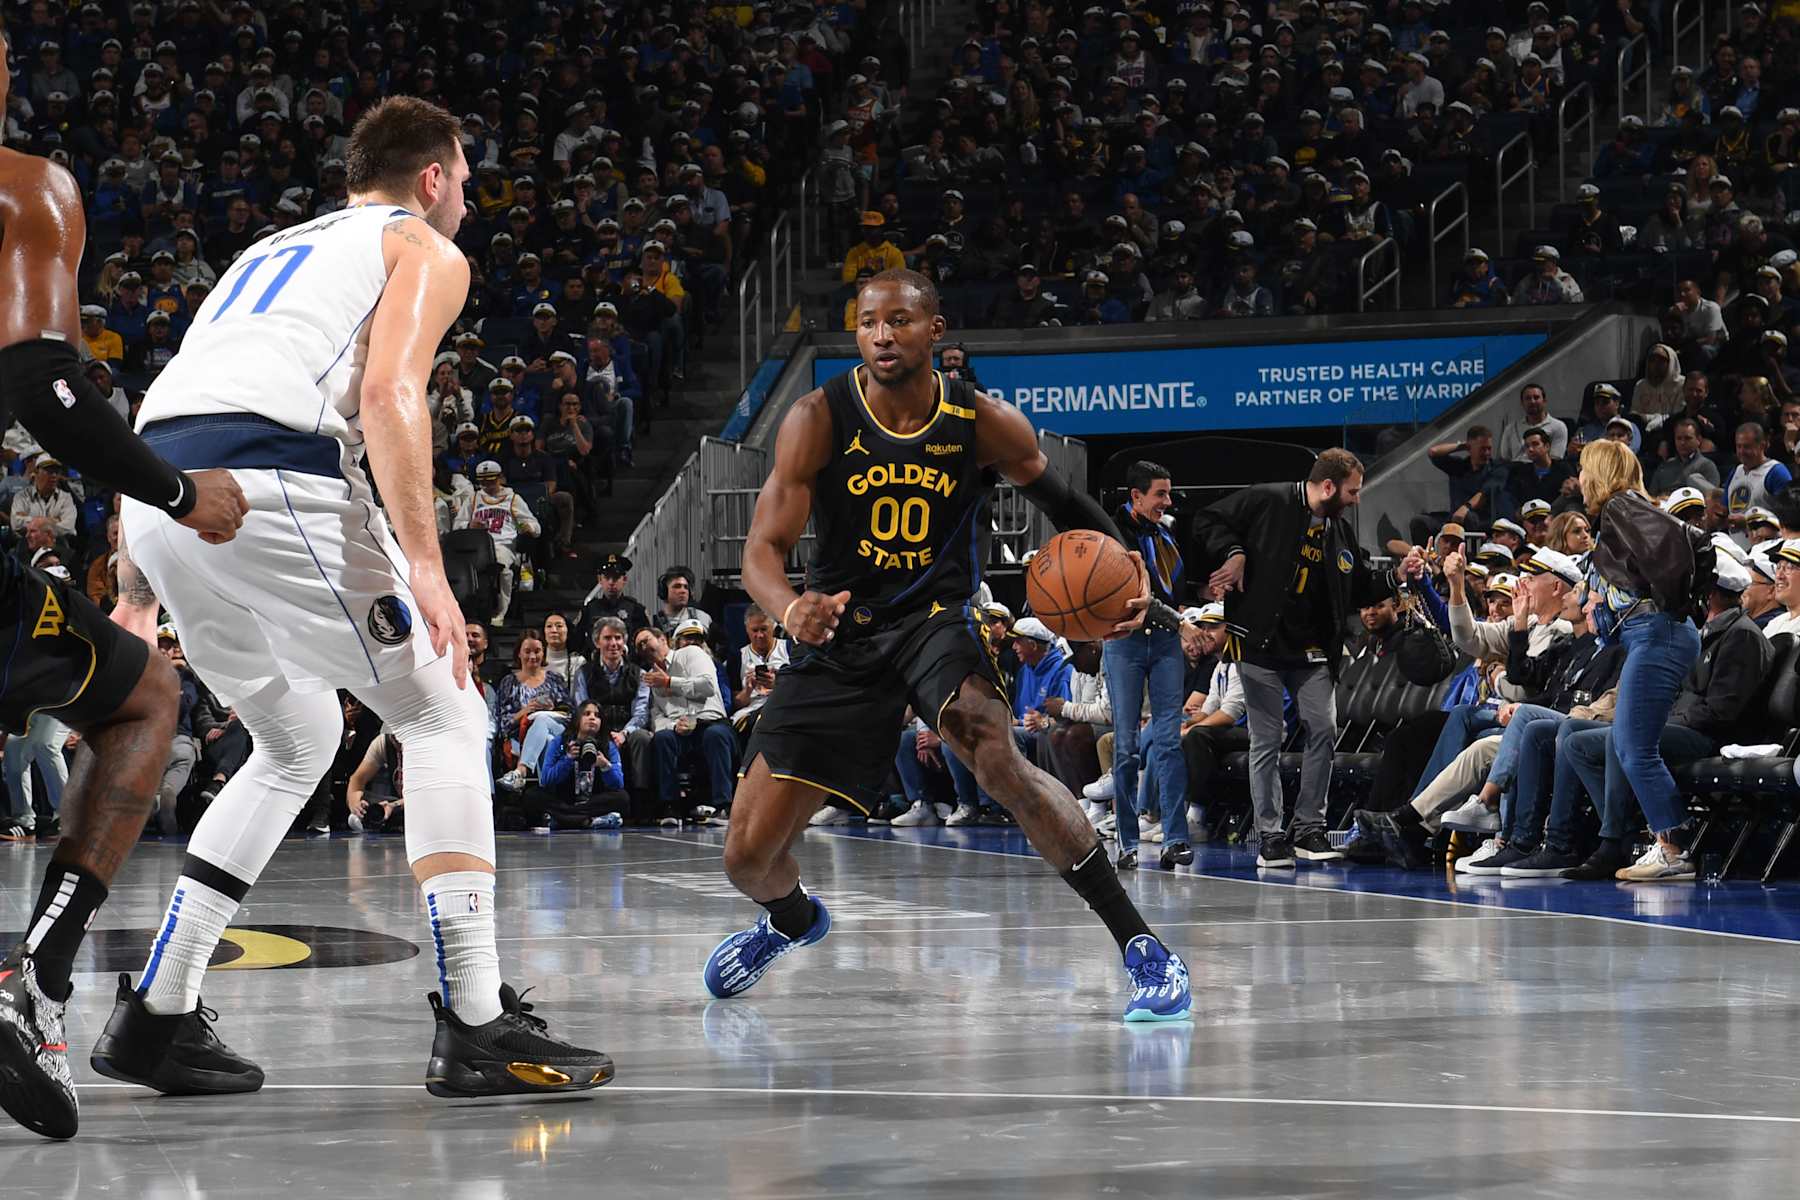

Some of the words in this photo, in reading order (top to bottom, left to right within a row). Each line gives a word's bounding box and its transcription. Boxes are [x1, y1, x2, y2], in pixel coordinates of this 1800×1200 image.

[209, 244, 314, 323] 77
[1258, 366, 1344, 383] TRUSTED
[1350, 362, 1424, 380] HEALTH
[1430, 359, 1485, 376] CARE
[1234, 389, 1322, 407] PARTNER
[1328, 387, 1355, 403] OF
[1360, 386, 1399, 402] THE
[925, 443, 963, 455] Rakuten
[847, 463, 957, 498] GOLDEN
[871, 496, 930, 543] 00
[857, 539, 934, 570] STATE
